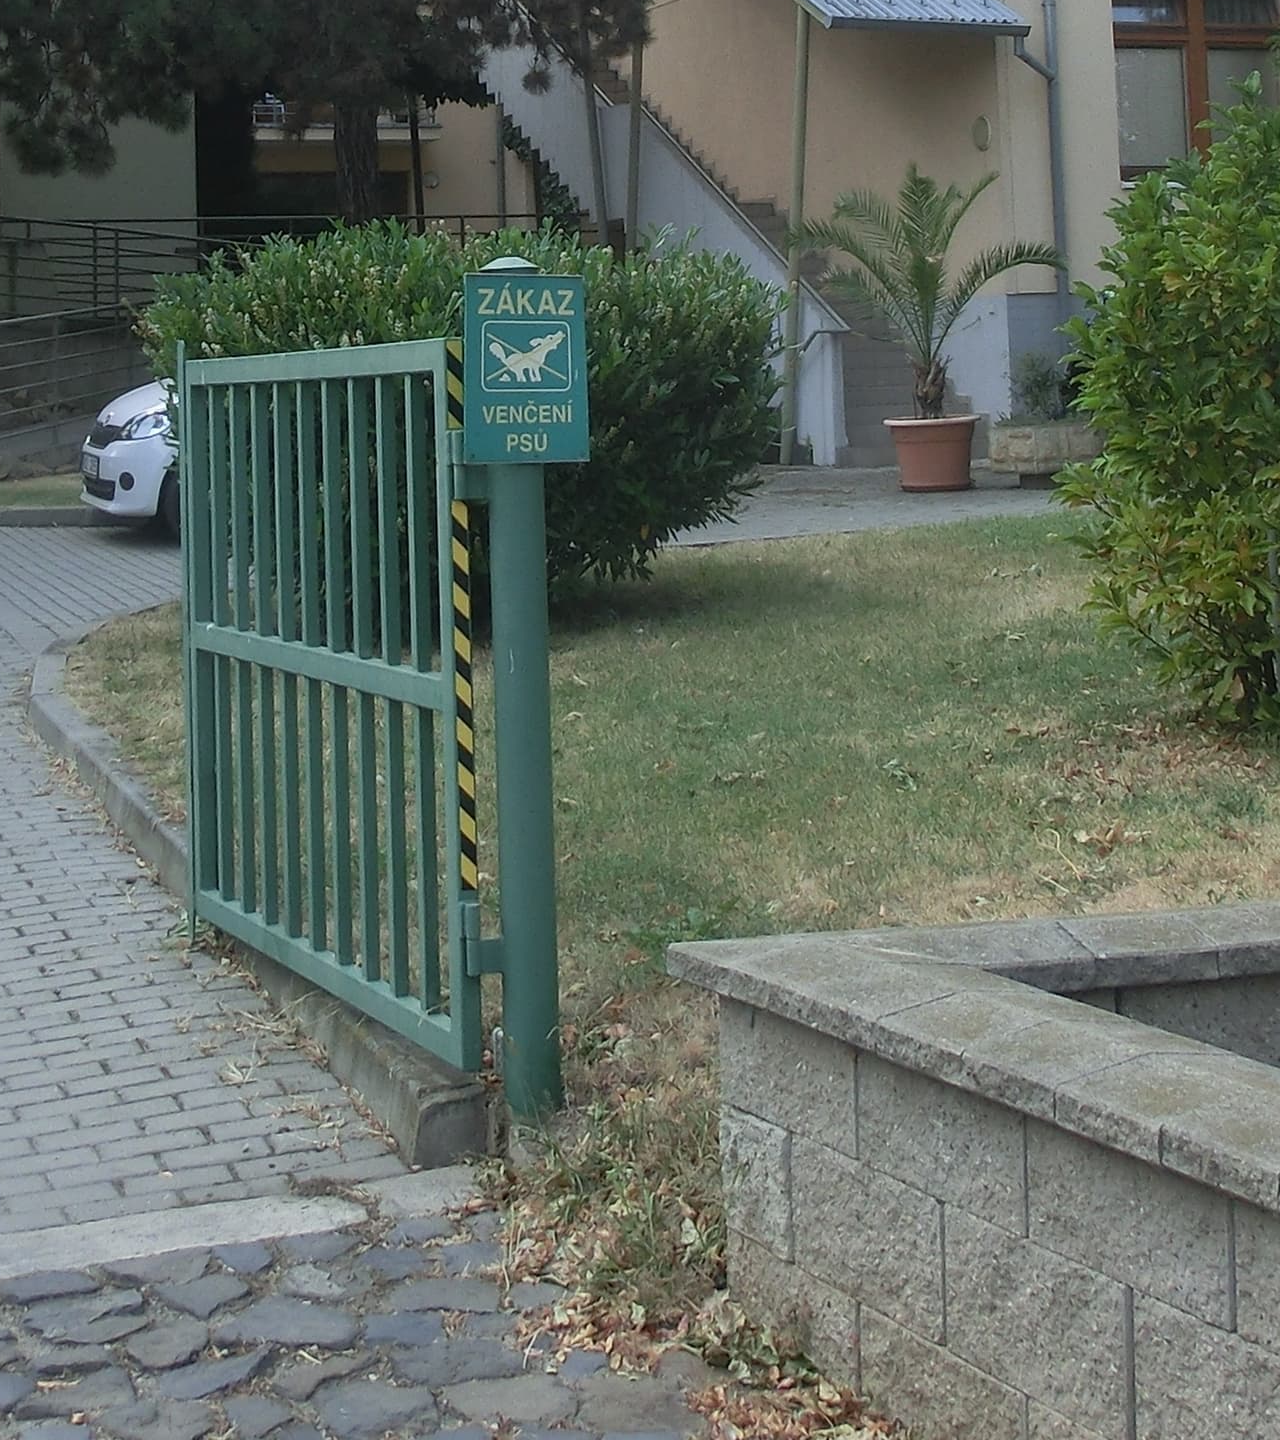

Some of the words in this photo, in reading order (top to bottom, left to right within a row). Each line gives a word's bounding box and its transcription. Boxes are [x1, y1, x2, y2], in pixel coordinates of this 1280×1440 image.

[477, 283, 575, 315] ZÁKAZ
[482, 399, 573, 423] VENČENÍ
[507, 427, 548, 452] PSŮ
